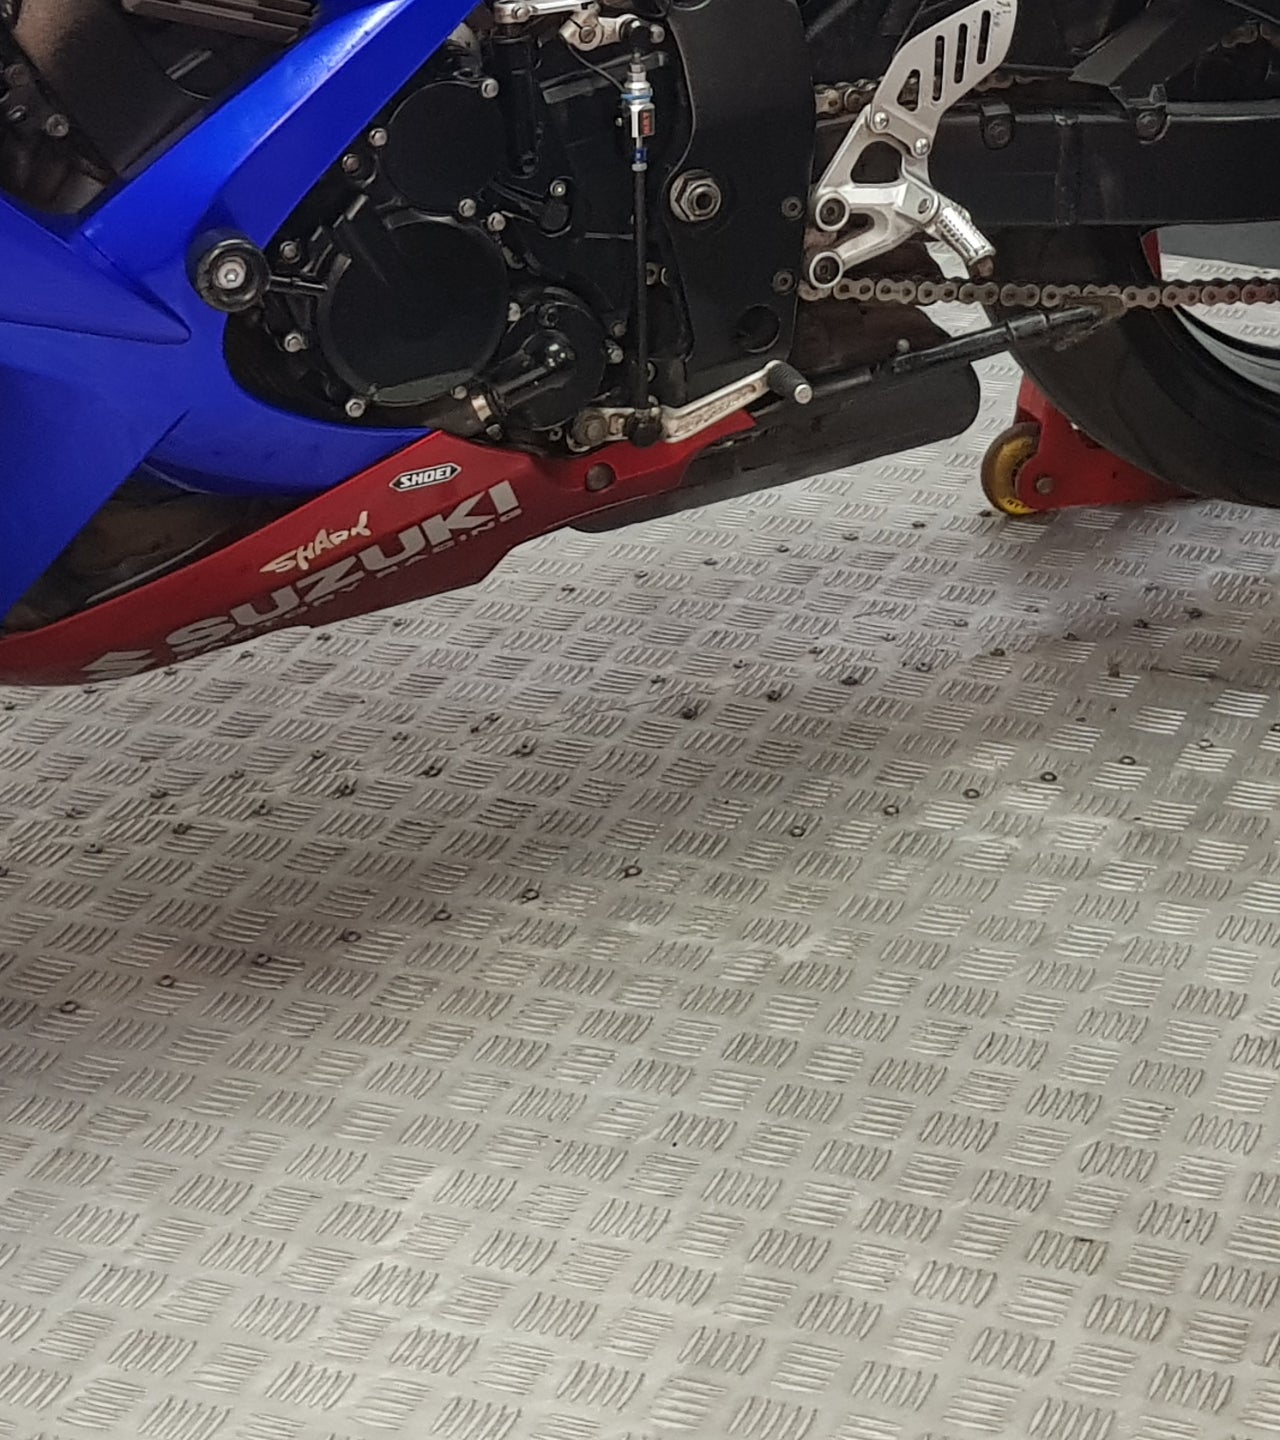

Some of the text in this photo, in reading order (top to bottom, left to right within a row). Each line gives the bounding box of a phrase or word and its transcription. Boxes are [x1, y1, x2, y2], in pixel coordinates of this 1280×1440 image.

[399, 466, 451, 488] SHOEI
[165, 480, 520, 653] SUZUKI
[259, 511, 372, 572] SHARK
